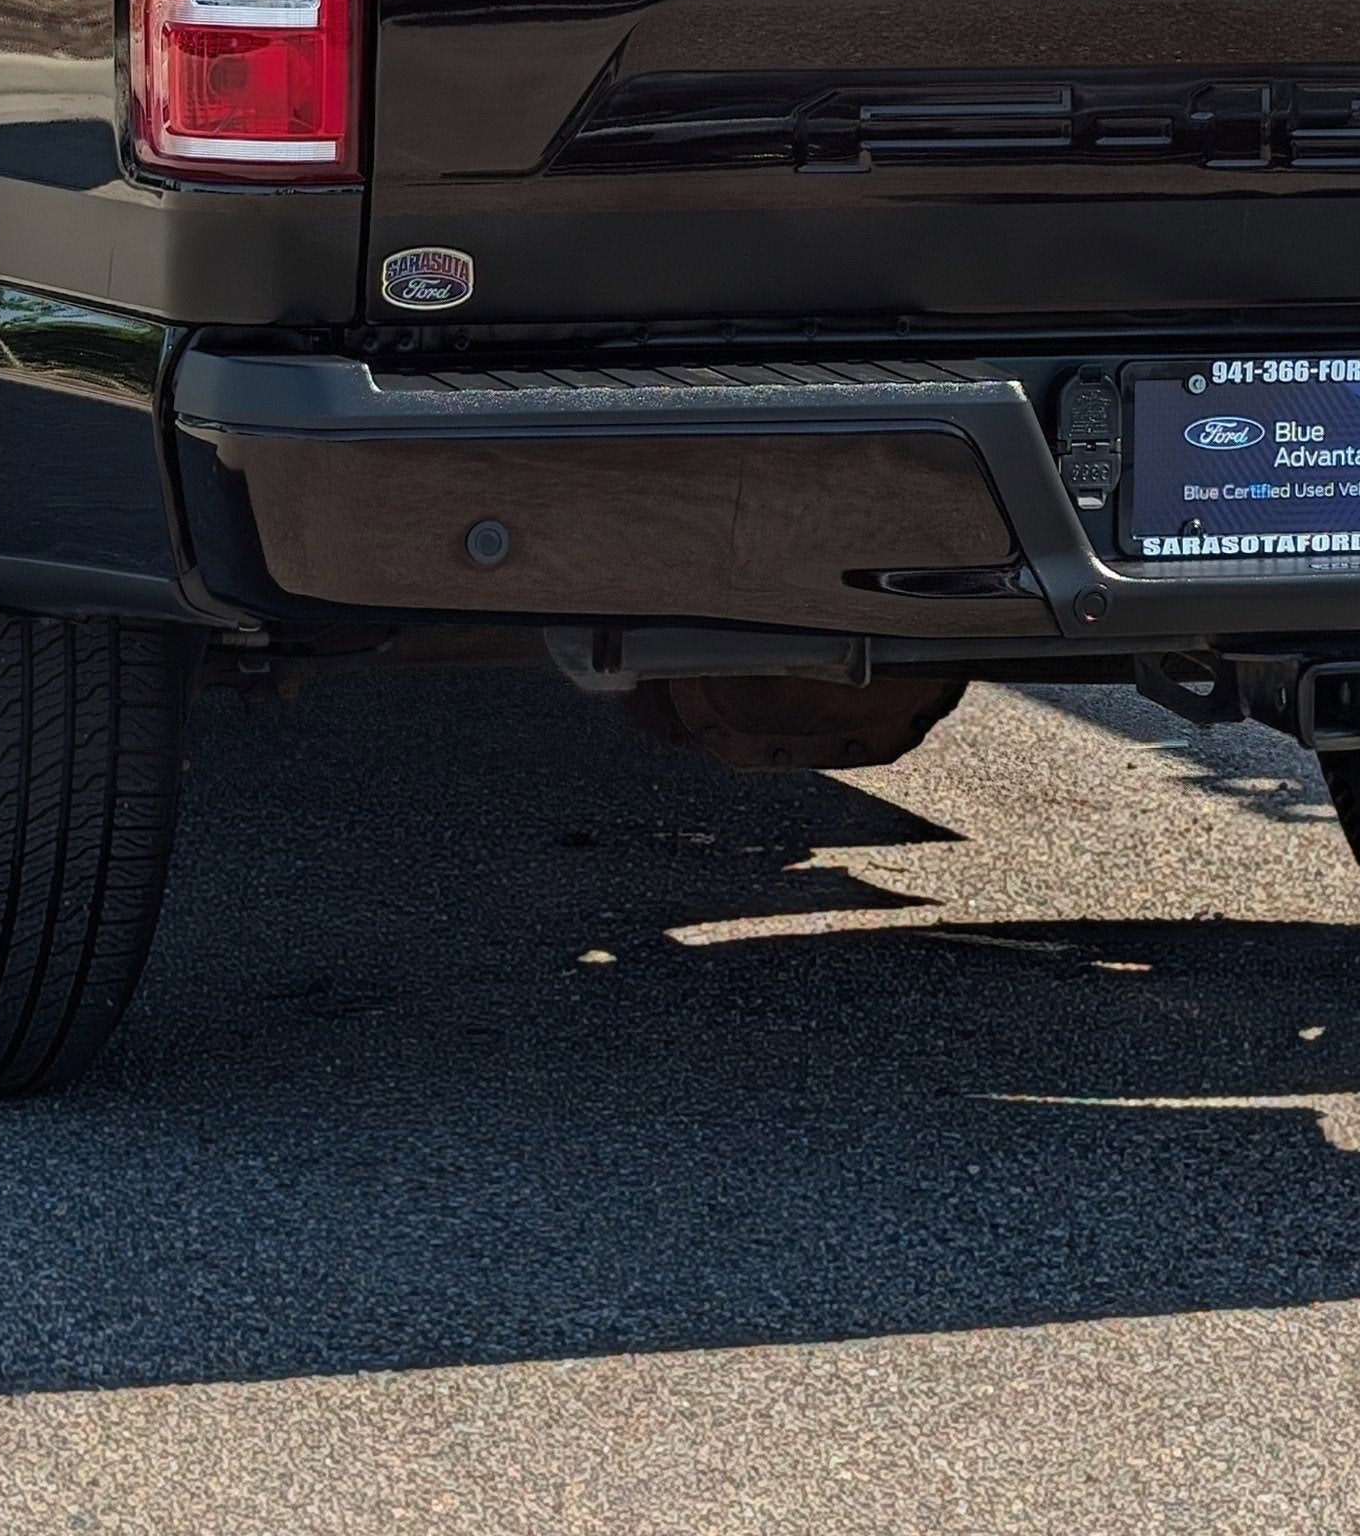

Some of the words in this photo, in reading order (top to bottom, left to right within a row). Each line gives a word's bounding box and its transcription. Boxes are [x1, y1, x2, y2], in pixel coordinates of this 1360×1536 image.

[386, 251, 469, 282] SARASOTA
[403, 278, 452, 300] Ford
[1199, 421, 1249, 444] Ford
[1275, 421, 1325, 443] Blue
[1183, 485, 1220, 500] Blue
[1223, 482, 1290, 500] Certified
[1294, 482, 1334, 498] Used
